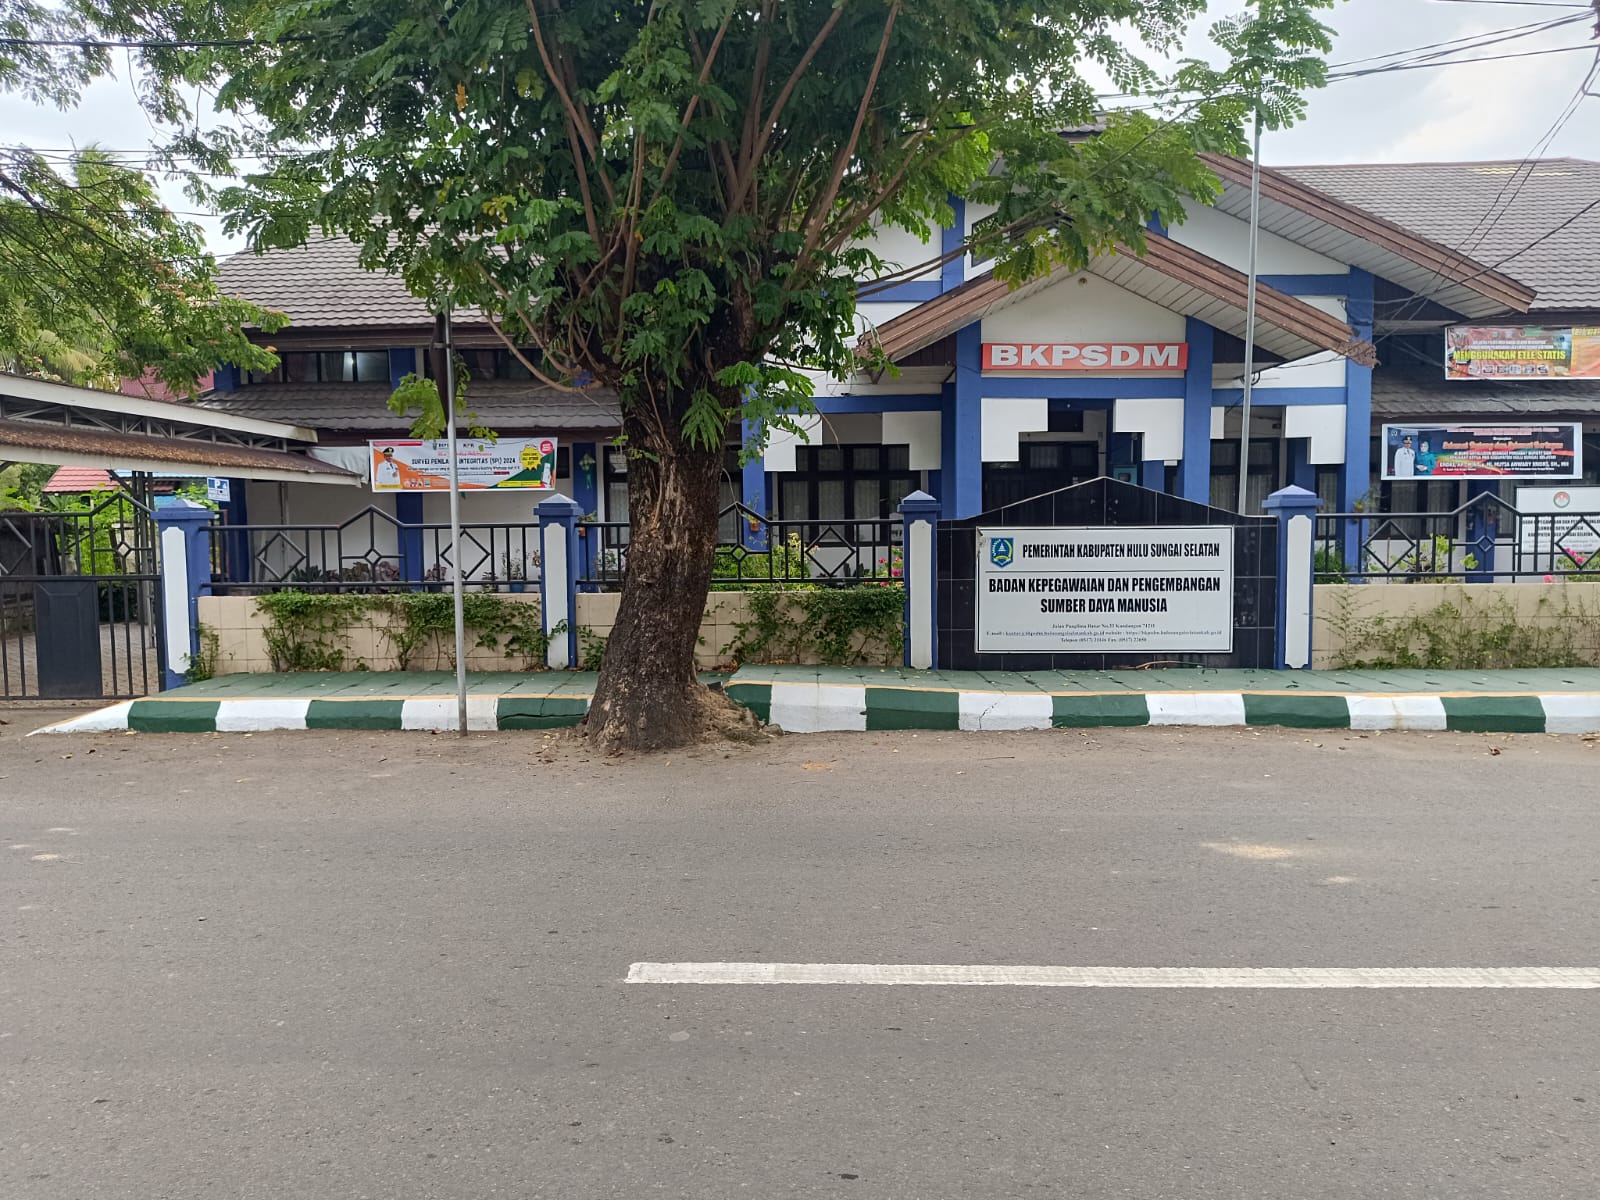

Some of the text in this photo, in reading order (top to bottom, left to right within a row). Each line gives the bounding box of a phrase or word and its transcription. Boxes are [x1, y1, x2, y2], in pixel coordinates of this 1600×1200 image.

[991, 345, 1179, 366] BKPSDM
[1022, 543, 1220, 558] PEMERINTAH KABUPATEN HULU SUNGAI SELATAN
[989, 577, 1220, 592] BADAN KEPEGAWAIAN DAN PENGEMBANGAN
[1040, 598, 1168, 613] SUMBER DAYA MANUSIA
